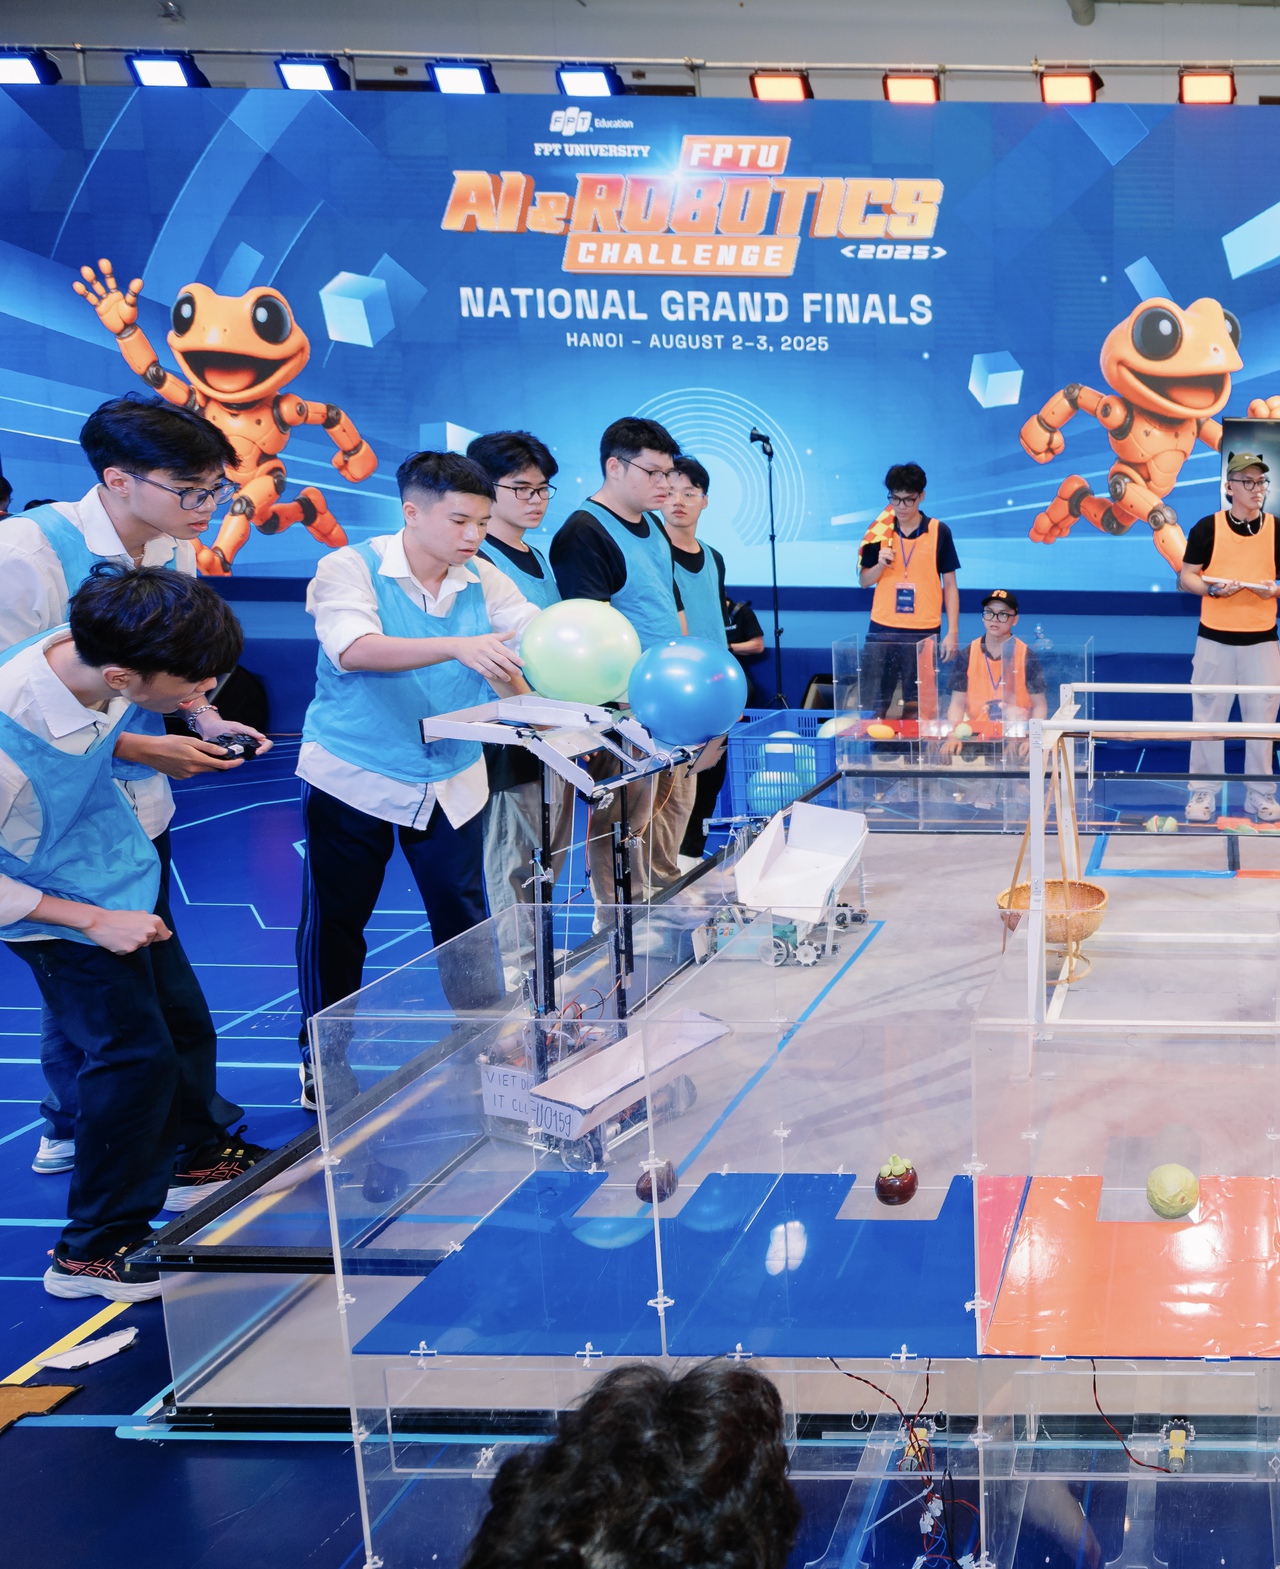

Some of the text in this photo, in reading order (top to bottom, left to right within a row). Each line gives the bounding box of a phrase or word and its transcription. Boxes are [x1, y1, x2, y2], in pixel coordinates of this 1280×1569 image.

[550, 107, 634, 136] FPT Education
[534, 142, 651, 157] FPT UNIVERSITY
[689, 143, 779, 169] FPTU
[576, 241, 784, 268] CHALLENGE
[459, 286, 934, 326] NATIONAL GRAND FINALS
[566, 332, 624, 349] HANOI
[649, 333, 724, 351] AUGUST
[779, 335, 830, 352] 2025
[493, 1094, 505, 1108] IT
